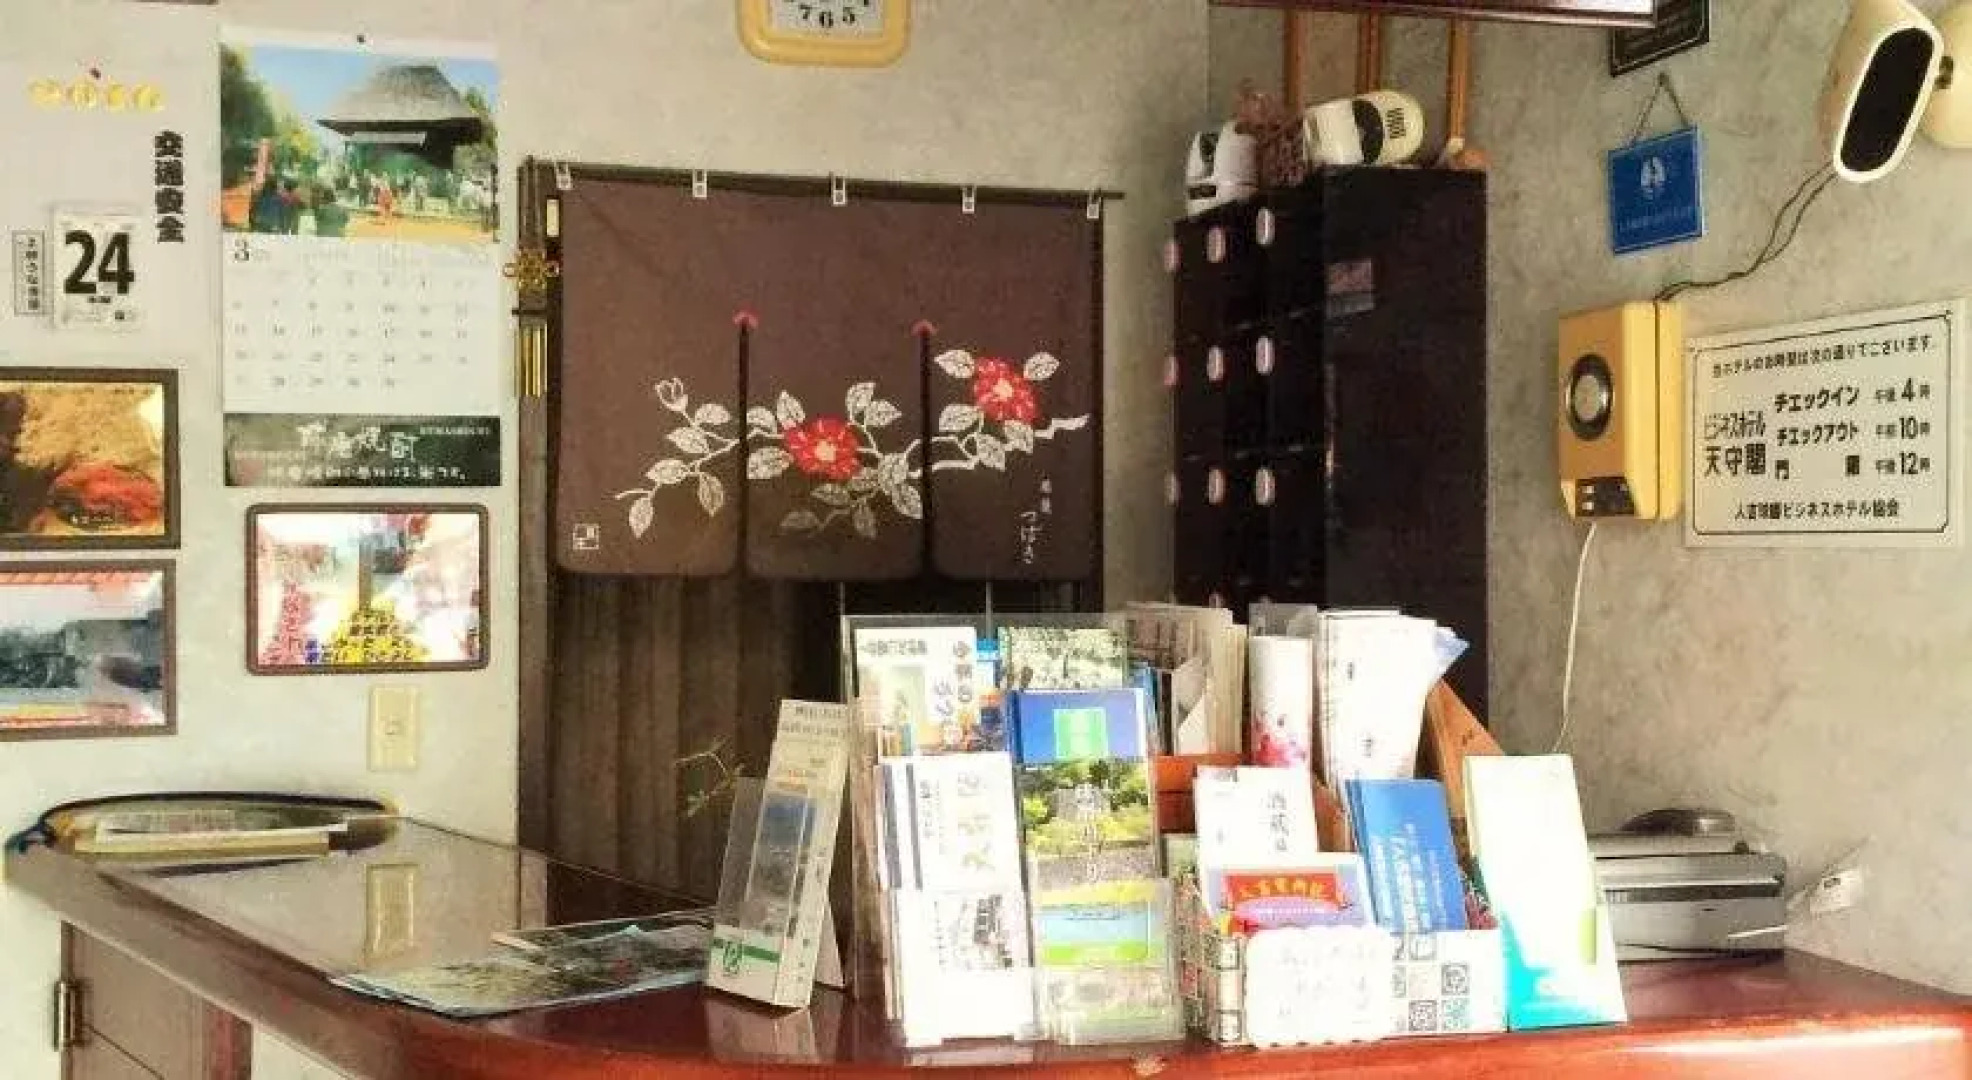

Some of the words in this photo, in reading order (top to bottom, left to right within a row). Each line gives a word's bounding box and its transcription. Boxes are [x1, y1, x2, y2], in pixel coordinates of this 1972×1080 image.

[799, 5, 813, 20] 7
[819, 10, 834, 28] 6
[842, 7, 856, 24] 5
[154, 129, 185, 243] 交通安全
[63, 230, 135, 295] 24
[234, 238, 250, 261] 3
[1774, 386, 1860, 413] チェックイン
[1703, 411, 1766, 440] ビジネスホテル
[1776, 422, 1860, 446] チェックアウト
[1703, 443, 1766, 477] 天守閣
